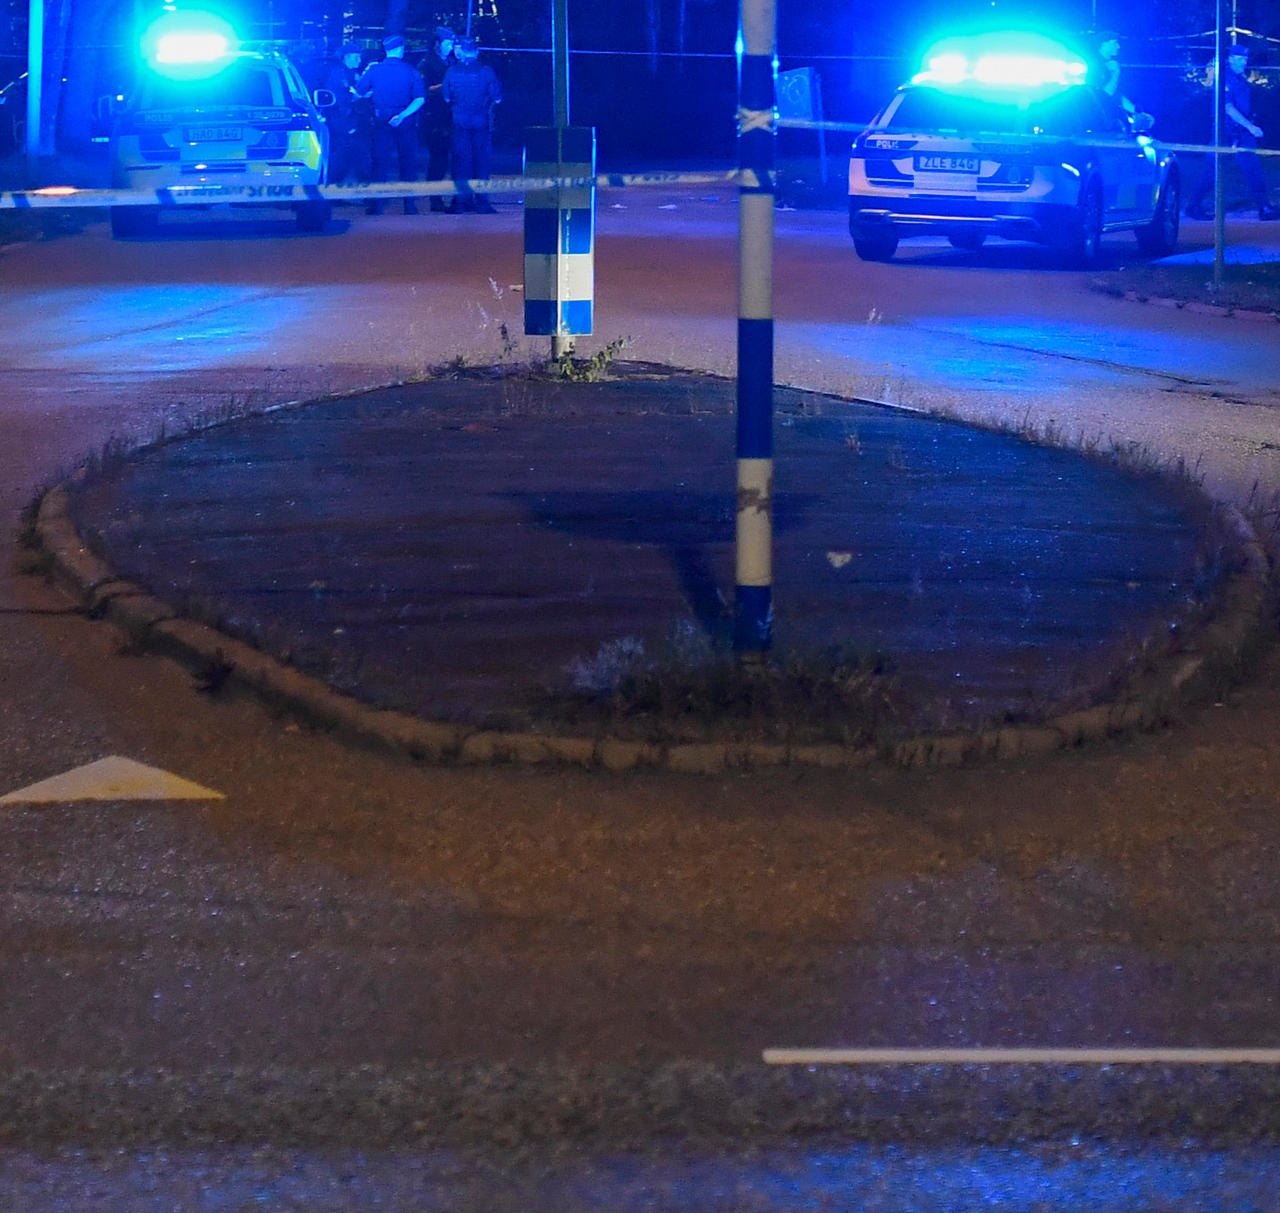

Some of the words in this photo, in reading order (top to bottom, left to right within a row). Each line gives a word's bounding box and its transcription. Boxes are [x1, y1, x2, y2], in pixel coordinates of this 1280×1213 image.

[144, 114, 172, 122] POLIS
[192, 129, 213, 140] HAD
[217, 128, 238, 139] 84G
[876, 140, 900, 149] POLIS
[923, 157, 947, 169] ZLE
[951, 158, 975, 170] 84G
